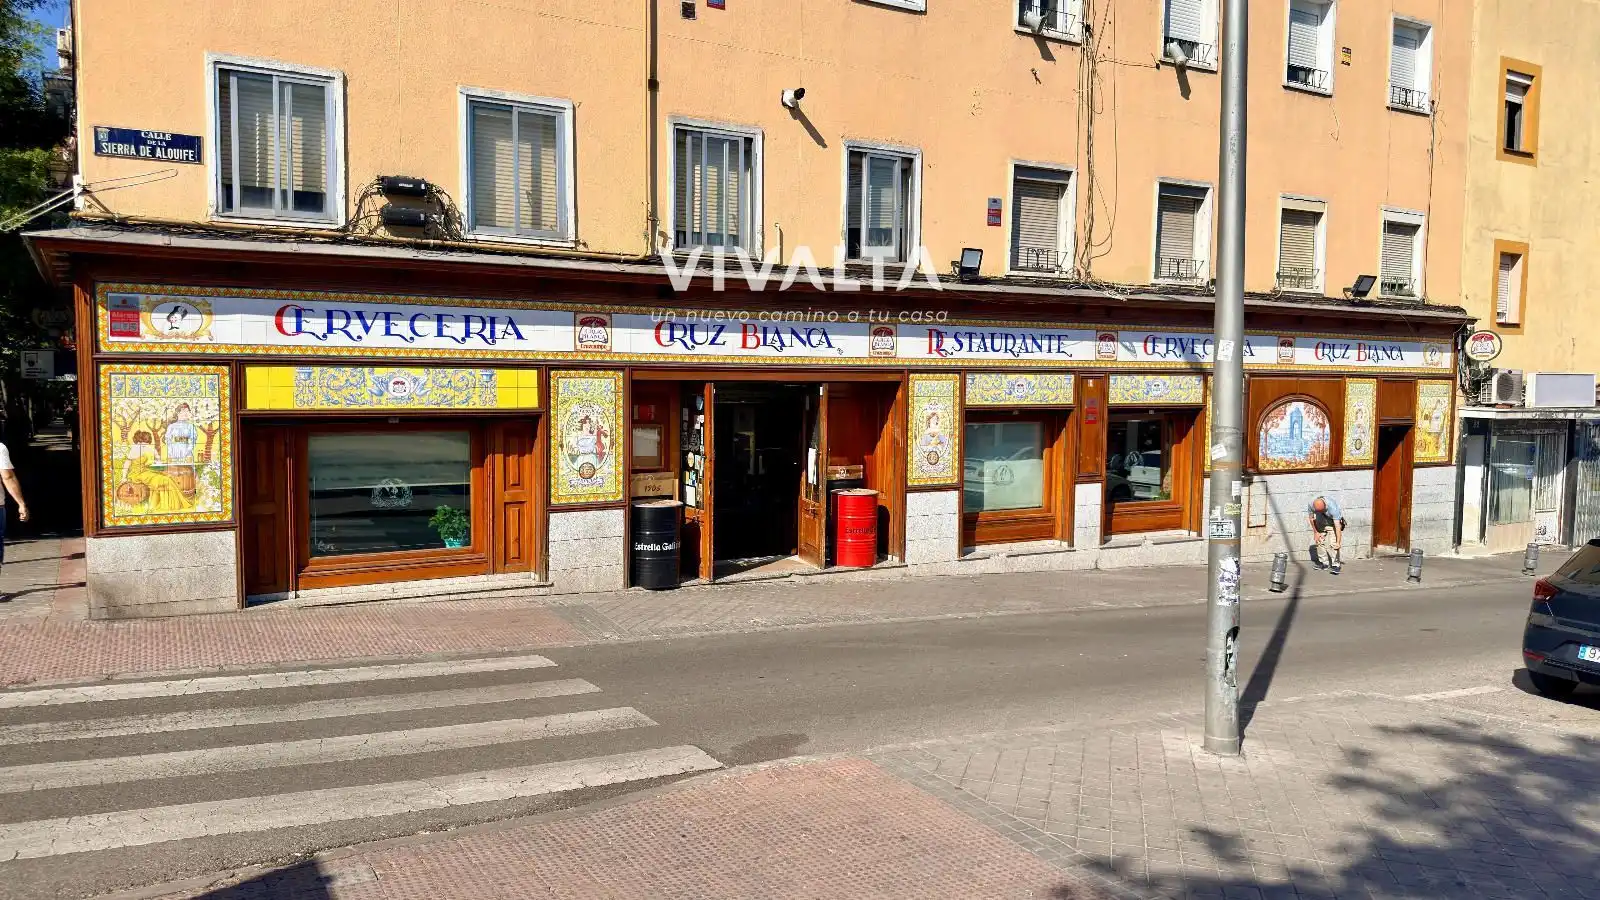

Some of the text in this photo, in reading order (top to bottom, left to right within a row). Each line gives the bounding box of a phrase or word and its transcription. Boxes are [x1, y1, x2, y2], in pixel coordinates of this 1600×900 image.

[102, 142, 136, 156] SIERRA
[140, 145, 152, 157] DE
[141, 131, 171, 141] CALLE
[274, 303, 529, 346] CERVECERIA
[654, 320, 836, 353] CRUZ BLANCA
[925, 327, 1074, 358] RESTAURANTE
[1314, 341, 1352, 363] CRUZ
[1355, 342, 1405, 364] BLANCA
